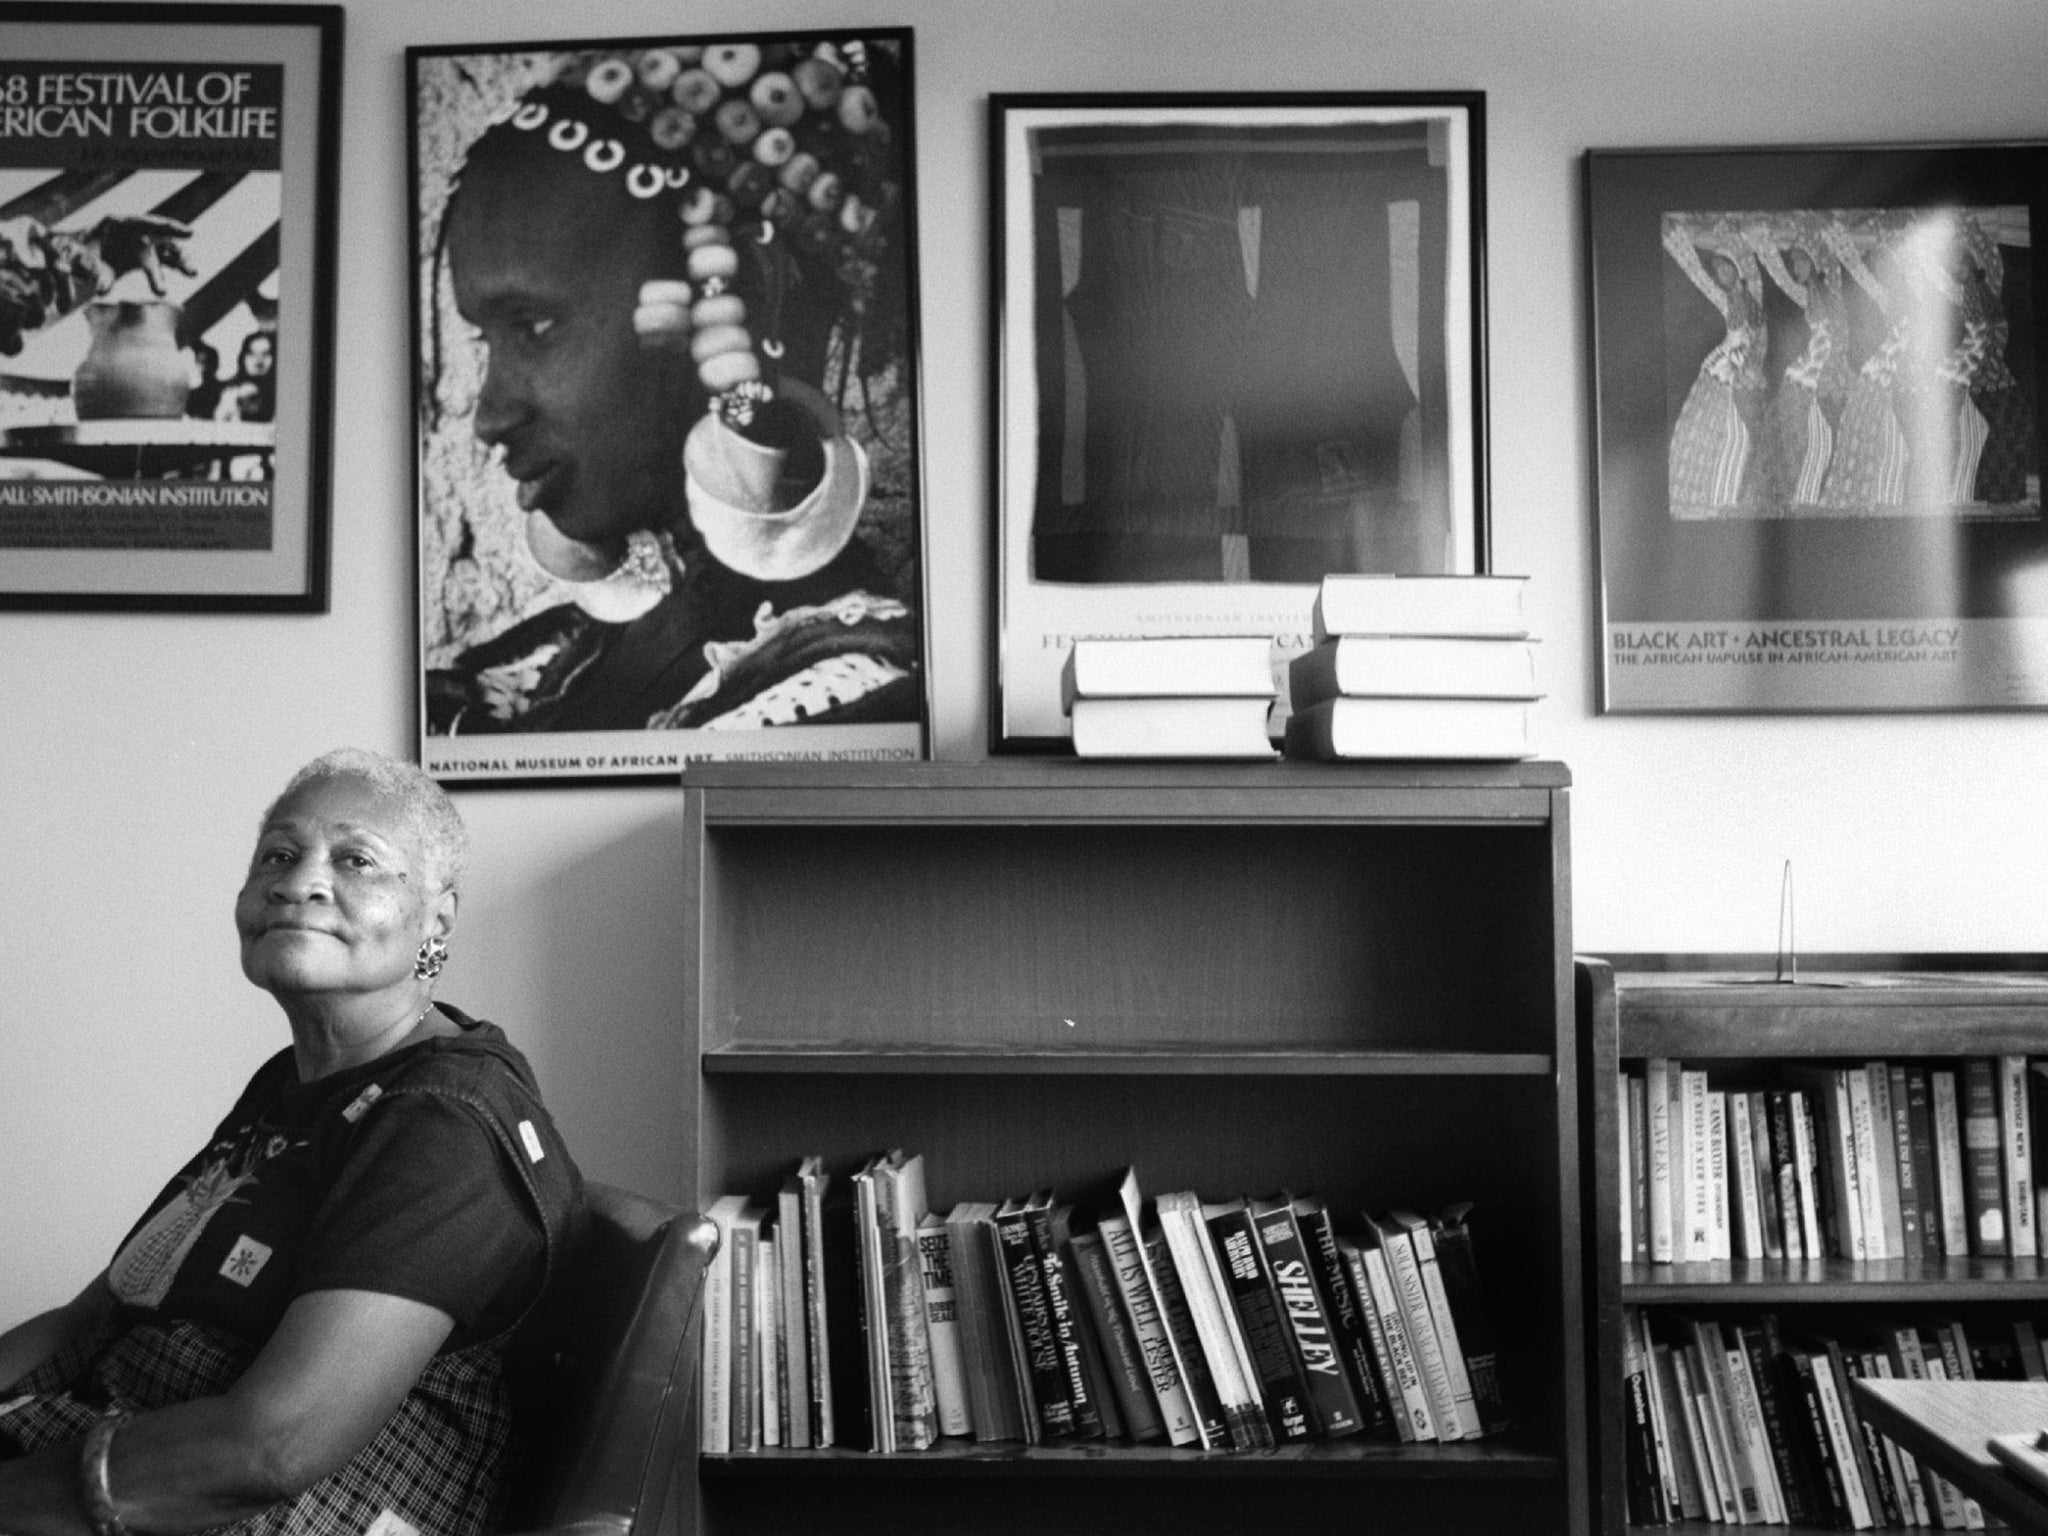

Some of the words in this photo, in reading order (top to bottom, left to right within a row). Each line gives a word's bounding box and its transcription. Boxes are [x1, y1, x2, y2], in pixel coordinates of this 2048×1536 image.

[0, 74, 28, 105] 8
[39, 73, 193, 105] FESTIVAL
[197, 72, 251, 105] OF
[130, 107, 277, 139] FOLKLIFE
[32, 486, 154, 507] SMITHSONIAN
[160, 486, 268, 507] INSTITUTION
[1613, 630, 1679, 650] BLACK
[1687, 630, 1729, 649] ART
[1745, 629, 1871, 649] ANCESTRAL
[1877, 628, 1959, 648] LEGACY
[1613, 653, 1638, 666] THE
[1643, 652, 1702, 666] AFRICAN
[1707, 652, 1763, 665] IMPULSE
[1768, 652, 1784, 665] IN
[1932, 650, 1957, 662] ART
[430, 759, 508, 773] NATIONAL
[515, 757, 580, 771] MUSEUM
[587, 756, 604, 769] OF
[610, 754, 678, 768] AFRICAN
[725, 750, 822, 763] SMITHSONIAN
[828, 748, 915, 762] INSTITUTION
[1652, 1102, 1667, 1184] SLAVERY
[2016, 1132, 2025, 1158] NEWS
[1109, 1225, 1134, 1258] ALL
[1315, 1222, 1338, 1260] THE
[1391, 1243, 1413, 1274] SOUL
[1043, 1252, 1063, 1274] To
[1120, 1264, 1144, 1283] IS
[1022, 1254, 1048, 1327] UPSTAIRS
[1043, 1344, 1058, 1366] THE
[1046, 1273, 1069, 1320] Smile
[1127, 1284, 1157, 1332] WELL
[1326, 1262, 1354, 1329] MUSIC
[1400, 1274, 1425, 1314] SISTER
[1012, 1262, 1036, 1316] WHITE
[1024, 1319, 1049, 1370] HOUSE
[1058, 1320, 1074, 1337] in
[1273, 1260, 1340, 1376] SHELLEY
[1141, 1336, 1170, 1394] LESTER
[1152, 1335, 1177, 1387] JULIUS
[1383, 1314, 1393, 1332] THE
[1388, 1334, 1403, 1365] BLACK
[1398, 1367, 1411, 1390] BELT
[1390, 1309, 1409, 1358] GROWING
[1403, 1360, 1414, 1374] UP
[1409, 1376, 1417, 1386] IN
[1062, 1340, 1087, 1408] Autumn
[1631, 1373, 1646, 1425] Ourselves
